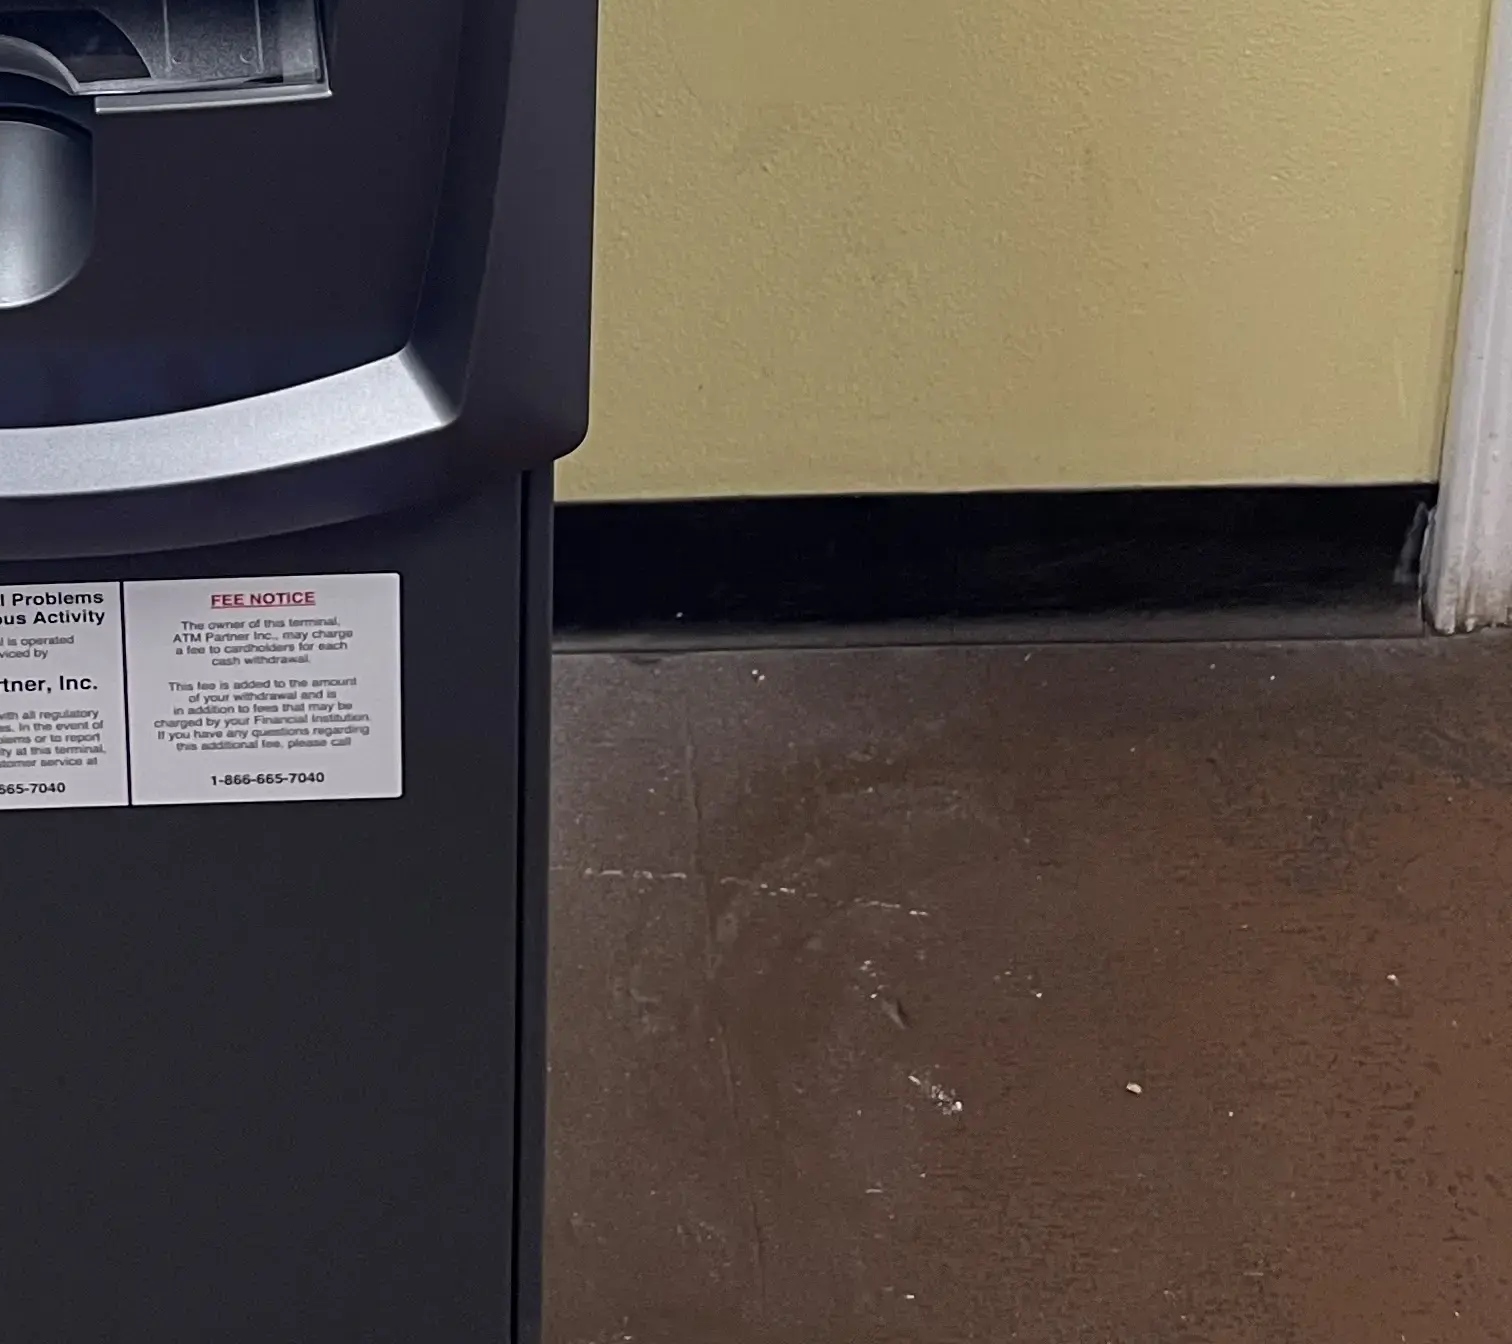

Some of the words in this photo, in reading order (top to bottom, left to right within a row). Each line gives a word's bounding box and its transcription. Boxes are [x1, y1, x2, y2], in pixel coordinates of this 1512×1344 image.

[13, 591, 104, 606] Problems
[211, 594, 244, 607] FEE
[250, 592, 315, 605] NOTICE
[33, 609, 105, 626] Activity
[182, 620, 204, 630] The
[249, 619, 260, 628] of
[173, 633, 201, 643] ATM
[206, 631, 249, 642] Partner
[34, 648, 48, 659] by
[209, 645, 220, 654] to
[224, 642, 294, 653] cardholders
[319, 641, 347, 650] each
[212, 656, 240, 666] cash
[60, 676, 98, 691] Inc.
[169, 682, 193, 691] This
[274, 679, 285, 688] to
[189, 693, 200, 703] of
[204, 694, 229, 705] your
[238, 703, 249, 713] to
[56, 720, 89, 730] event
[92, 720, 103, 729] of
[154, 718, 202, 729] charged
[206, 717, 220, 728] by
[224, 717, 250, 728] your
[255, 714, 307, 724] Financial
[169, 731, 189, 741] you
[212, 772, 324, 786] 1-866-665-7040
